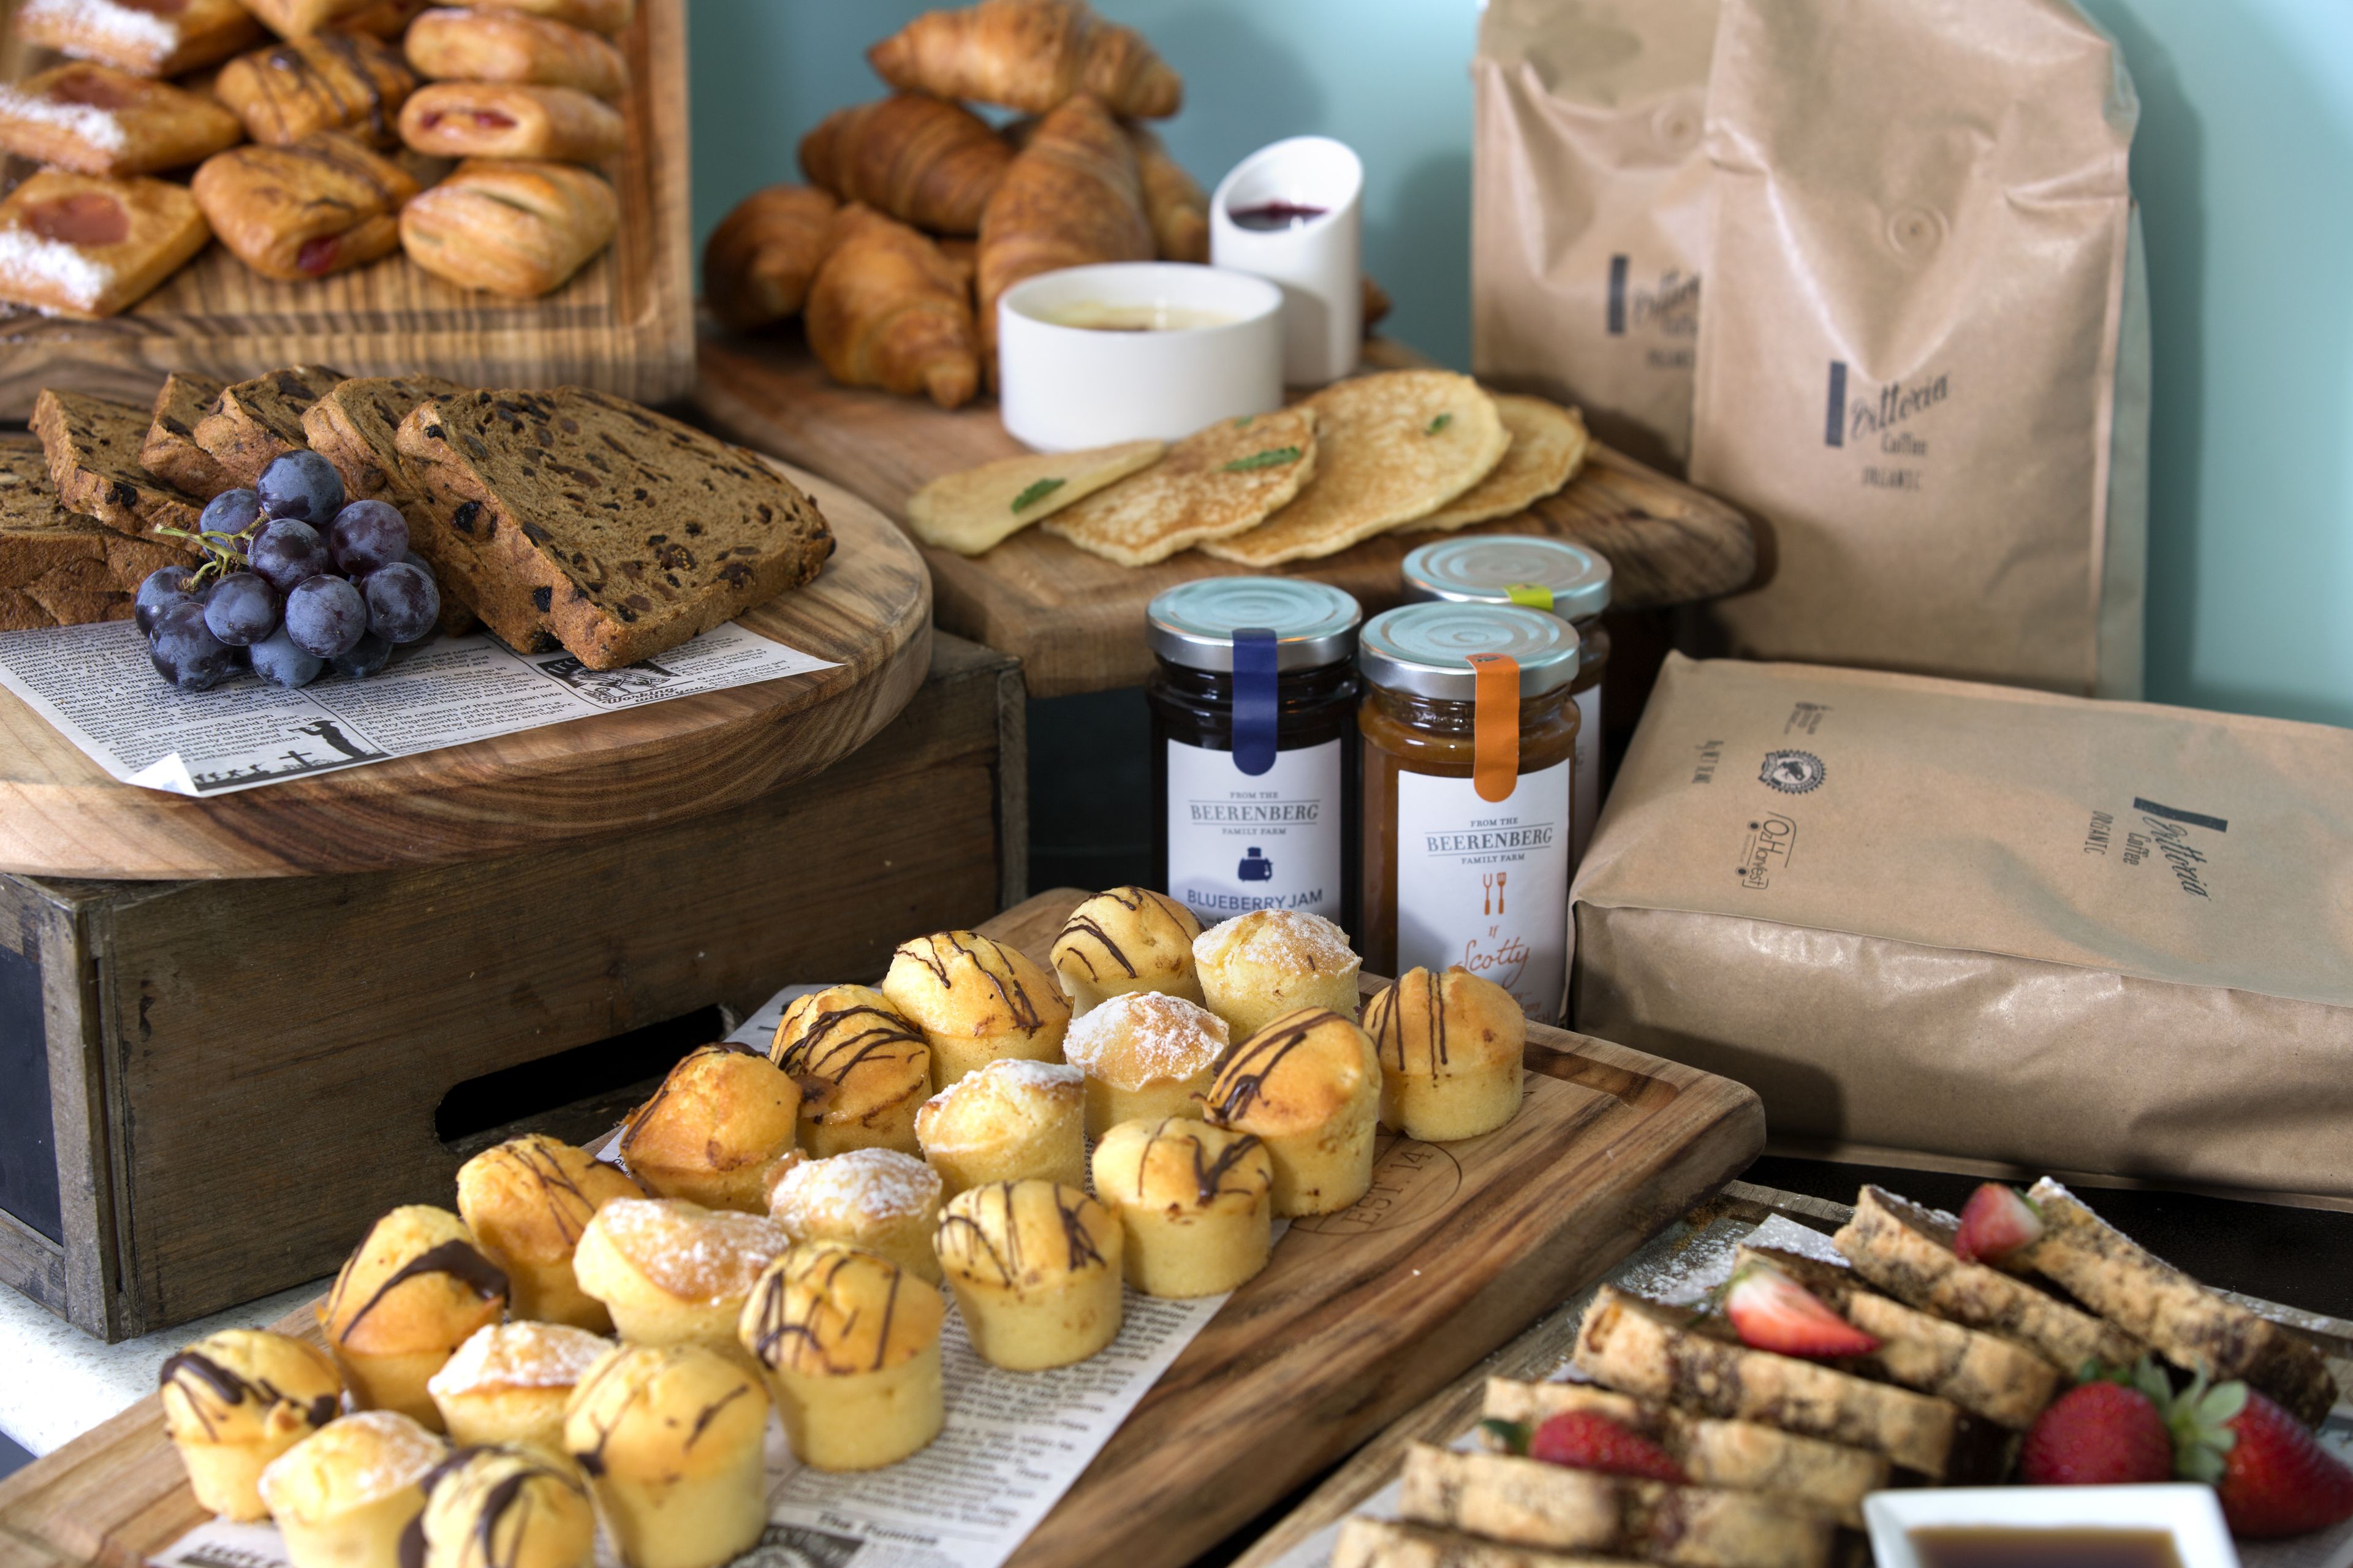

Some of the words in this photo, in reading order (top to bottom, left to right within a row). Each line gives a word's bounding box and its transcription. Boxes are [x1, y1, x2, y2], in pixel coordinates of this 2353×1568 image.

[104, 695, 142, 703] diaries
[601, 686, 678, 705] Working
[635, 691, 669, 703] with
[675, 686, 708, 695] you.
[61, 705, 108, 715] Zealand
[109, 698, 153, 708] soldiers
[67, 705, 135, 719] commenced
[81, 724, 114, 732] lunch
[118, 713, 176, 726] organized
[218, 698, 267, 710] activities
[104, 706, 156, 718] followed
[158, 694, 232, 710] mid-morning
[108, 721, 160, 733] proceeds
[199, 705, 253, 716] gambling
[254, 699, 287, 707] going
[414, 708, 458, 718] contents
[491, 695, 540, 705] saucepan
[416, 716, 462, 727] spoonful
[496, 705, 536, 714] mixture
[77, 710, 169, 728] commemorative
[91, 727, 145, 740] Battalion
[210, 708, 259, 718] occurred
[274, 699, 308, 708] Egypt
[371, 729, 413, 740] greased
[507, 708, 544, 717] around
[545, 702, 577, 710] 180°C
[399, 713, 458, 725] ingredients
[108, 740, 159, 752] Australia
[266, 714, 301, 723] Anzac
[112, 741, 173, 756] memorials
[267, 719, 301, 728] about
[181, 738, 219, 748] mainly
[222, 727, 280, 740] organized
[1189, 804, 1319, 821] BEERENBERG
[1500, 817, 1518, 825] THE
[1426, 827, 1553, 852] BEERENBERG
[2084, 809, 2113, 855] ORGANIC
[1461, 855, 1497, 865] FAMILY
[1501, 853, 1525, 862] FARM
[1749, 819, 1790, 886] OzHarvest
[2123, 832, 2151, 865] Coffee
[1187, 889, 1286, 911] BLUEBERRY
[1288, 889, 1323, 909] JAM
[1456, 937, 1530, 989] Scotty
